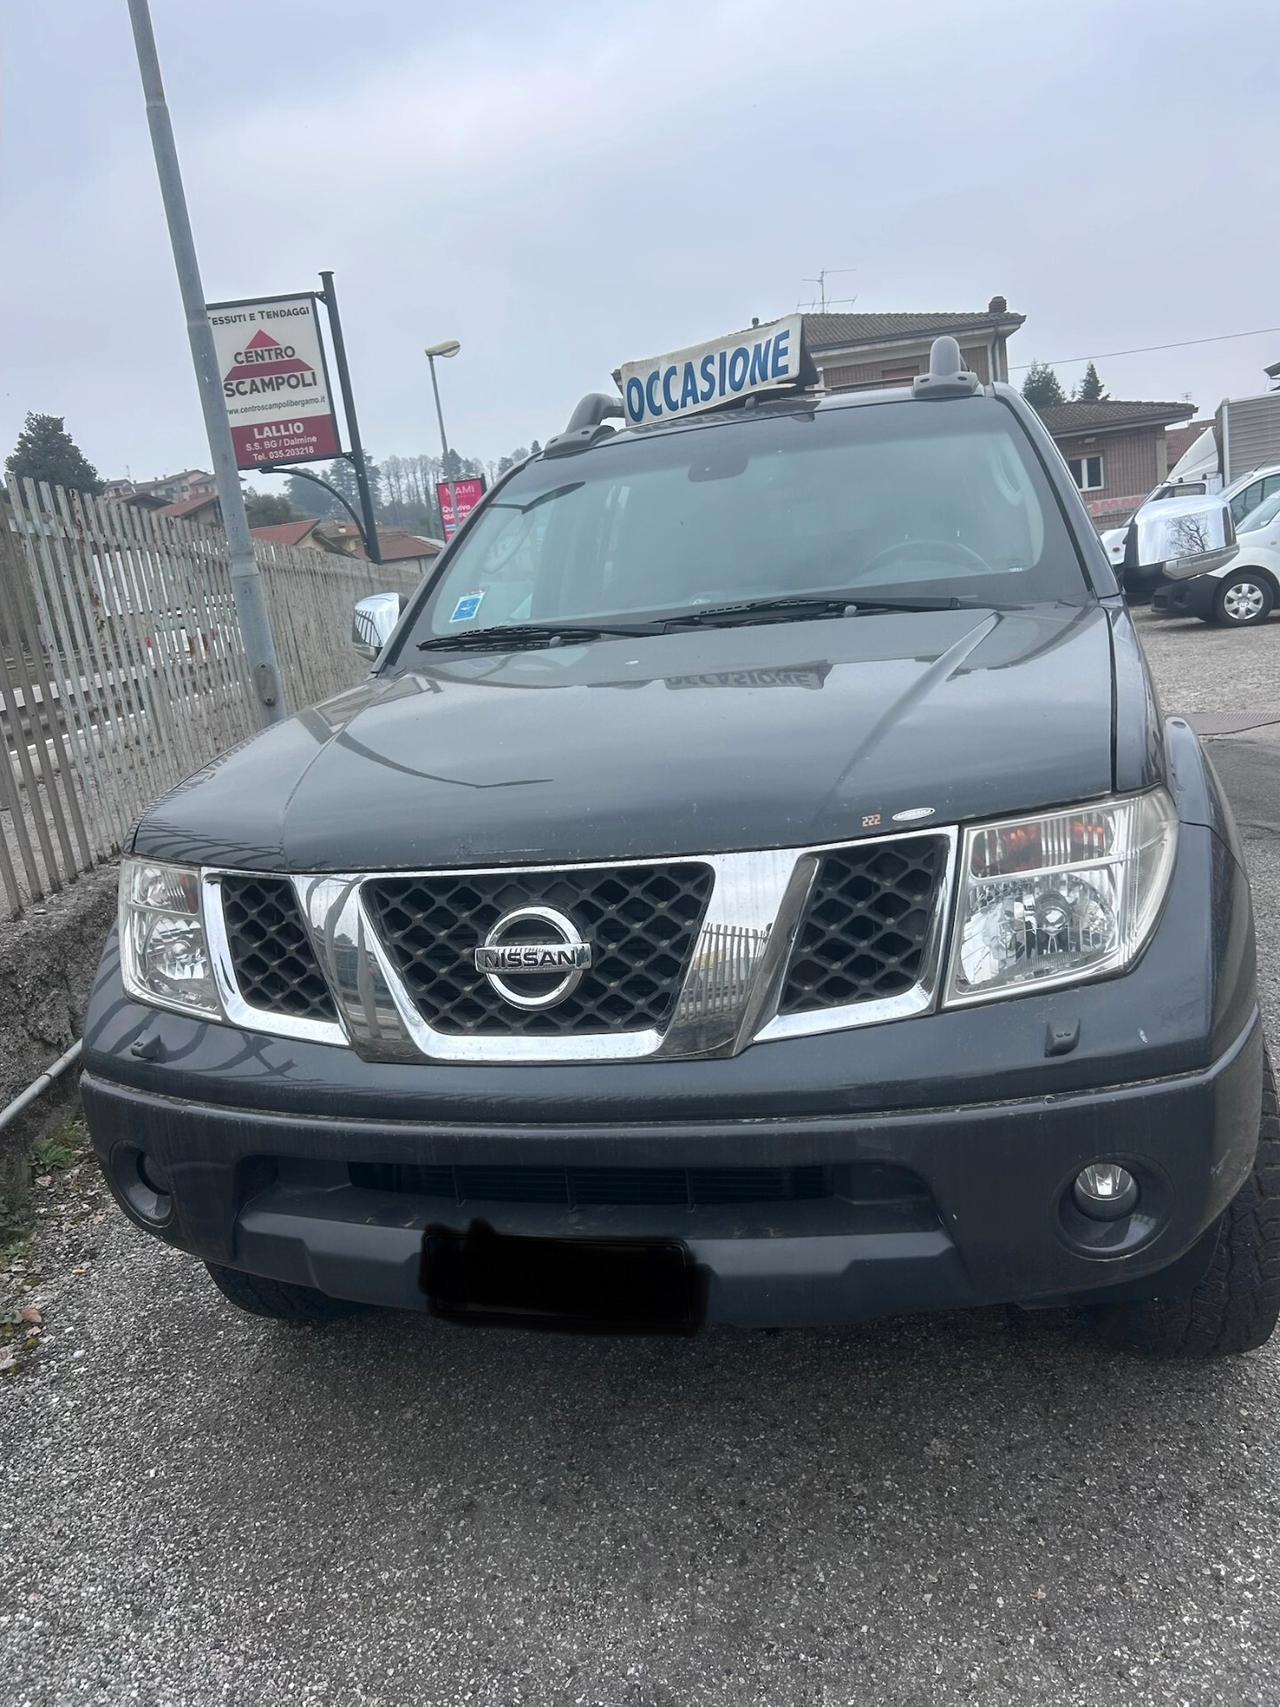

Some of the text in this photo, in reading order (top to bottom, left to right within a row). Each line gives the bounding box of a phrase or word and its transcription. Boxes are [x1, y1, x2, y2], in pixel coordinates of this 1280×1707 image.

[208, 306, 310, 326] ESSUTI E TENDAGGI
[234, 345, 296, 365] CENTRO
[223, 371, 318, 398] SCAMPOLI
[626, 329, 790, 422] OCCASIONE
[253, 421, 305, 440] LALLIO
[246, 442, 263, 452] S.S.
[264, 439, 278, 450] BG
[284, 435, 318, 447] Dalmine
[253, 445, 315, 462] Tel. 035.203218
[862, 814, 880, 828] 222
[484, 949, 576, 969] NISSAN
